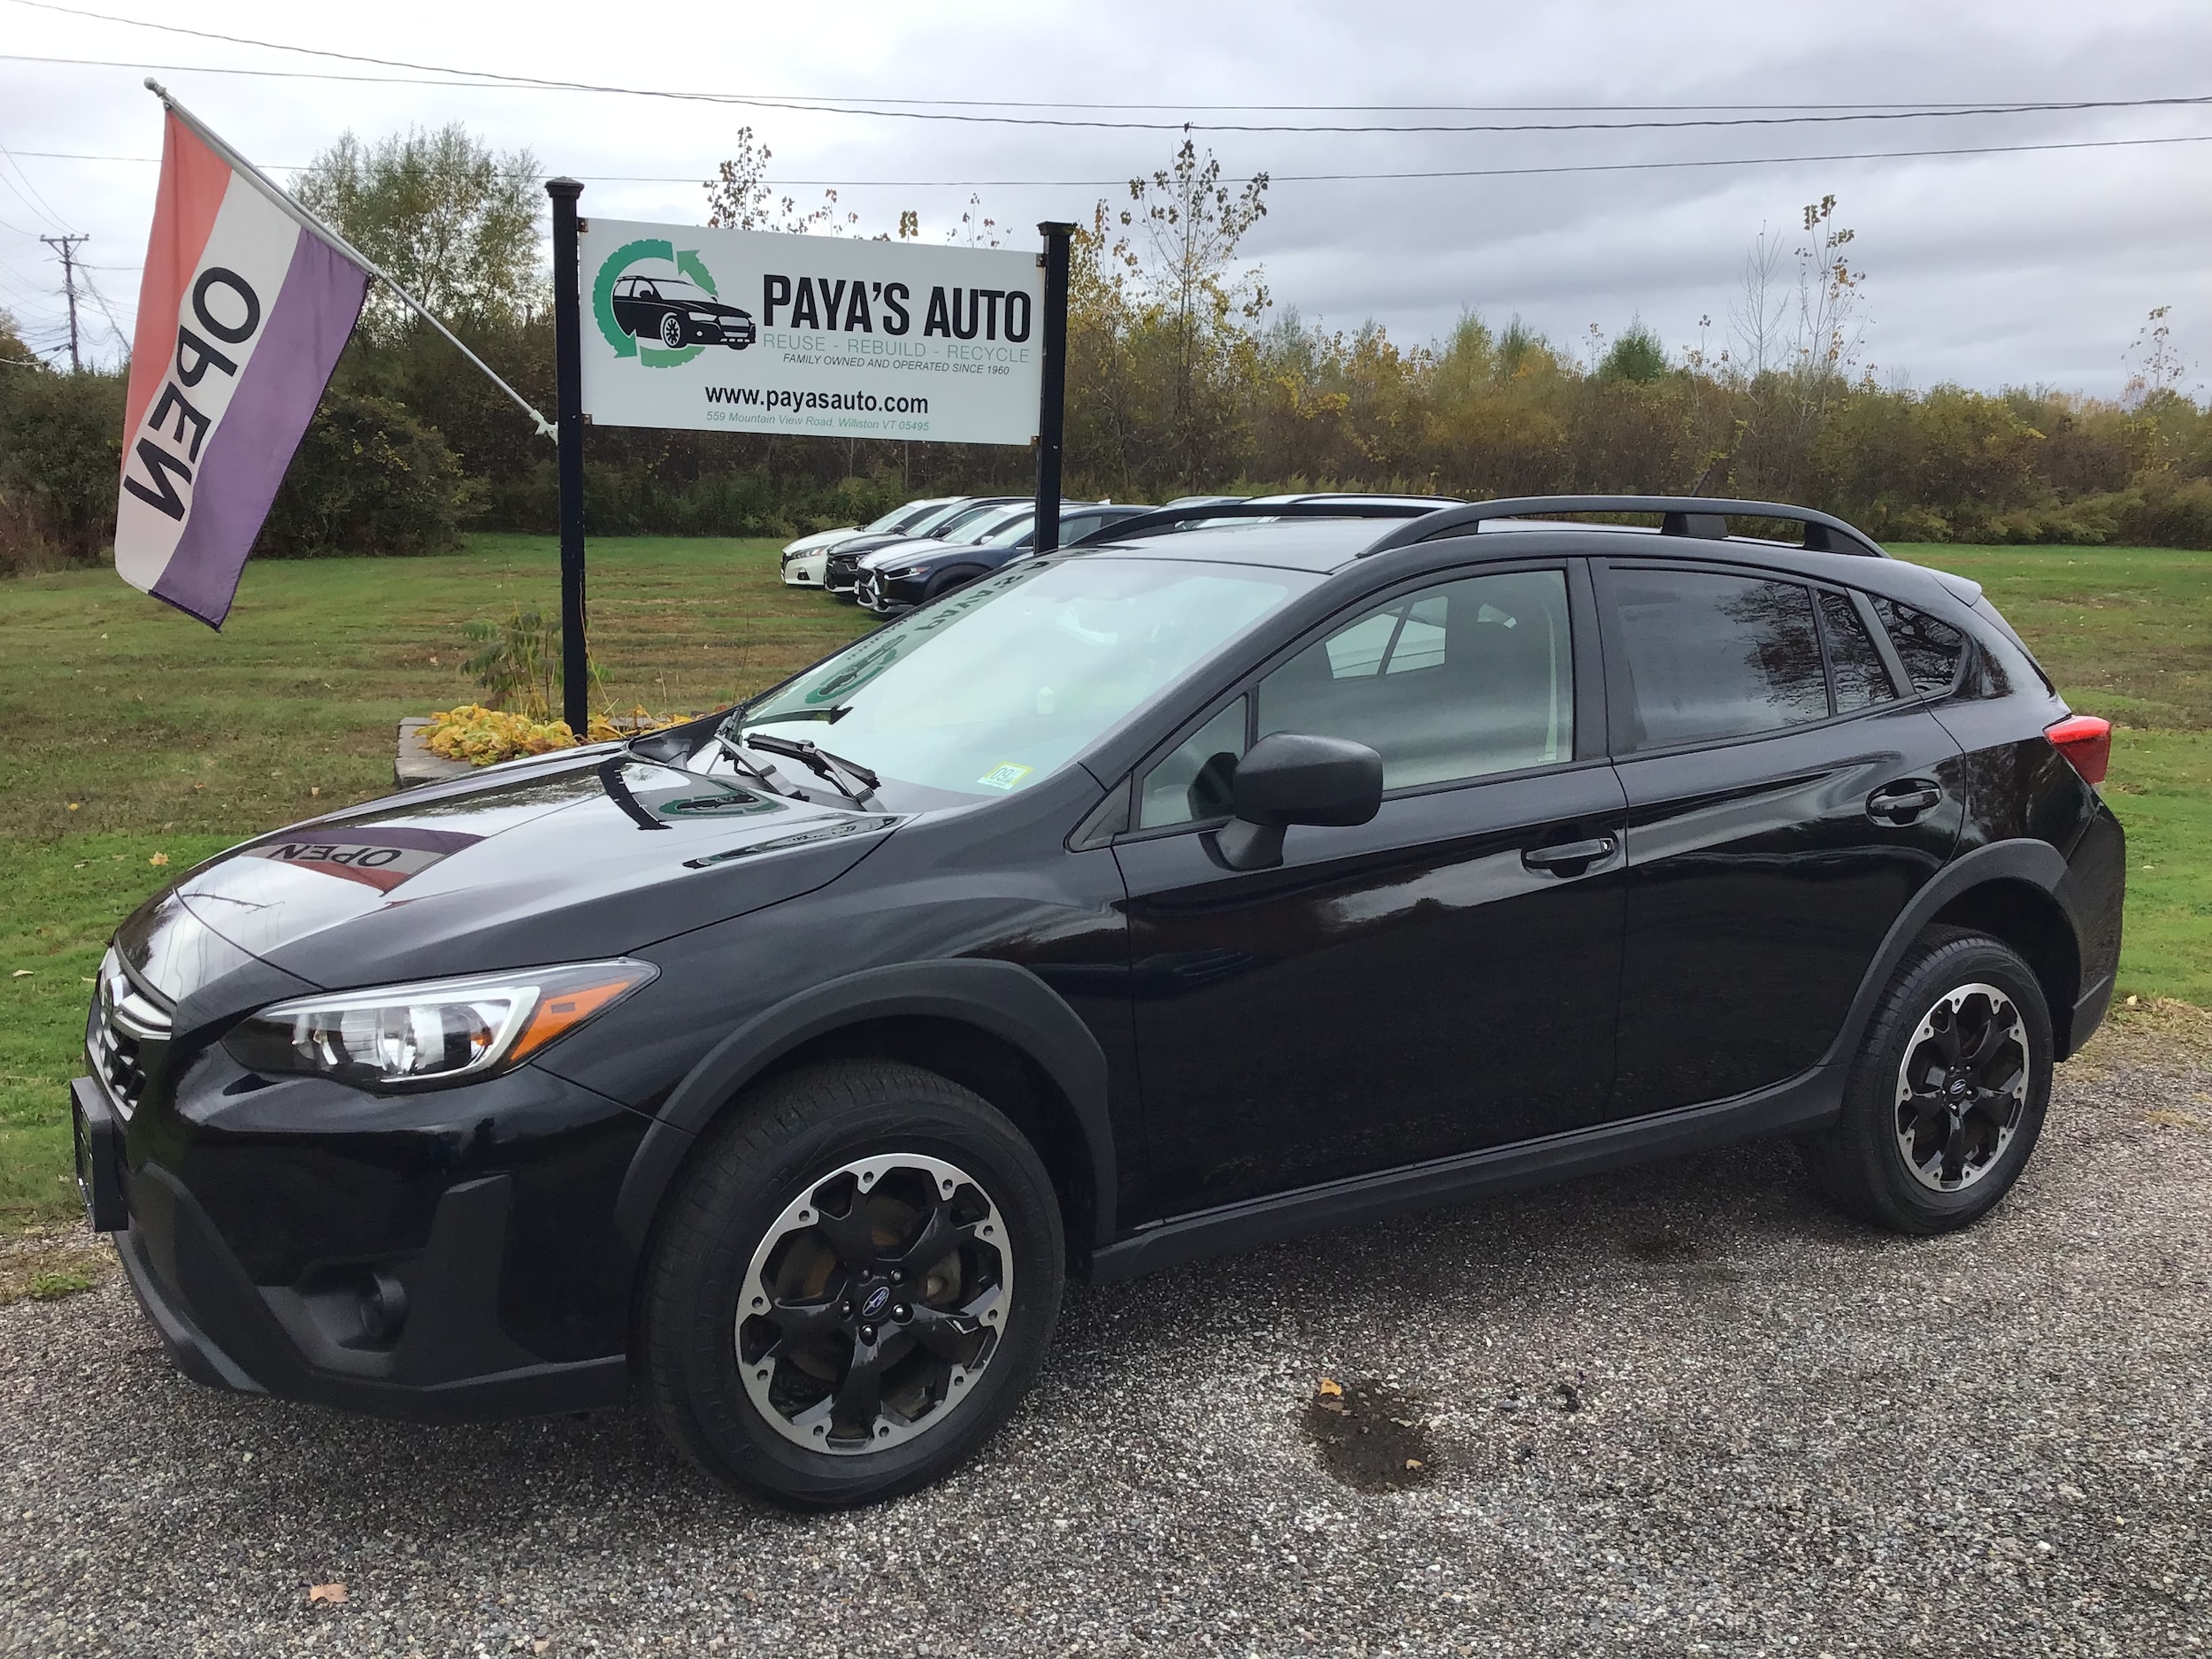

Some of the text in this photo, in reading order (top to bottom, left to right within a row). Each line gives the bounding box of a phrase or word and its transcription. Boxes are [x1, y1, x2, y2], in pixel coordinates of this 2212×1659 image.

[763, 273, 1032, 343] PAYA'S AUTO
[763, 333, 826, 352] REUSE
[847, 338, 926, 357] REBUILD
[947, 344, 1030, 364] RECYCLE
[783, 353, 1010, 376] FAMILY OWNED AND OPERATED SINCE 1960
[705, 386, 929, 414] www.payasauto.com
[706, 411, 930, 432] 559 Mountain View Road, Williston VT 05495
[266, 843, 403, 867] OPEN
